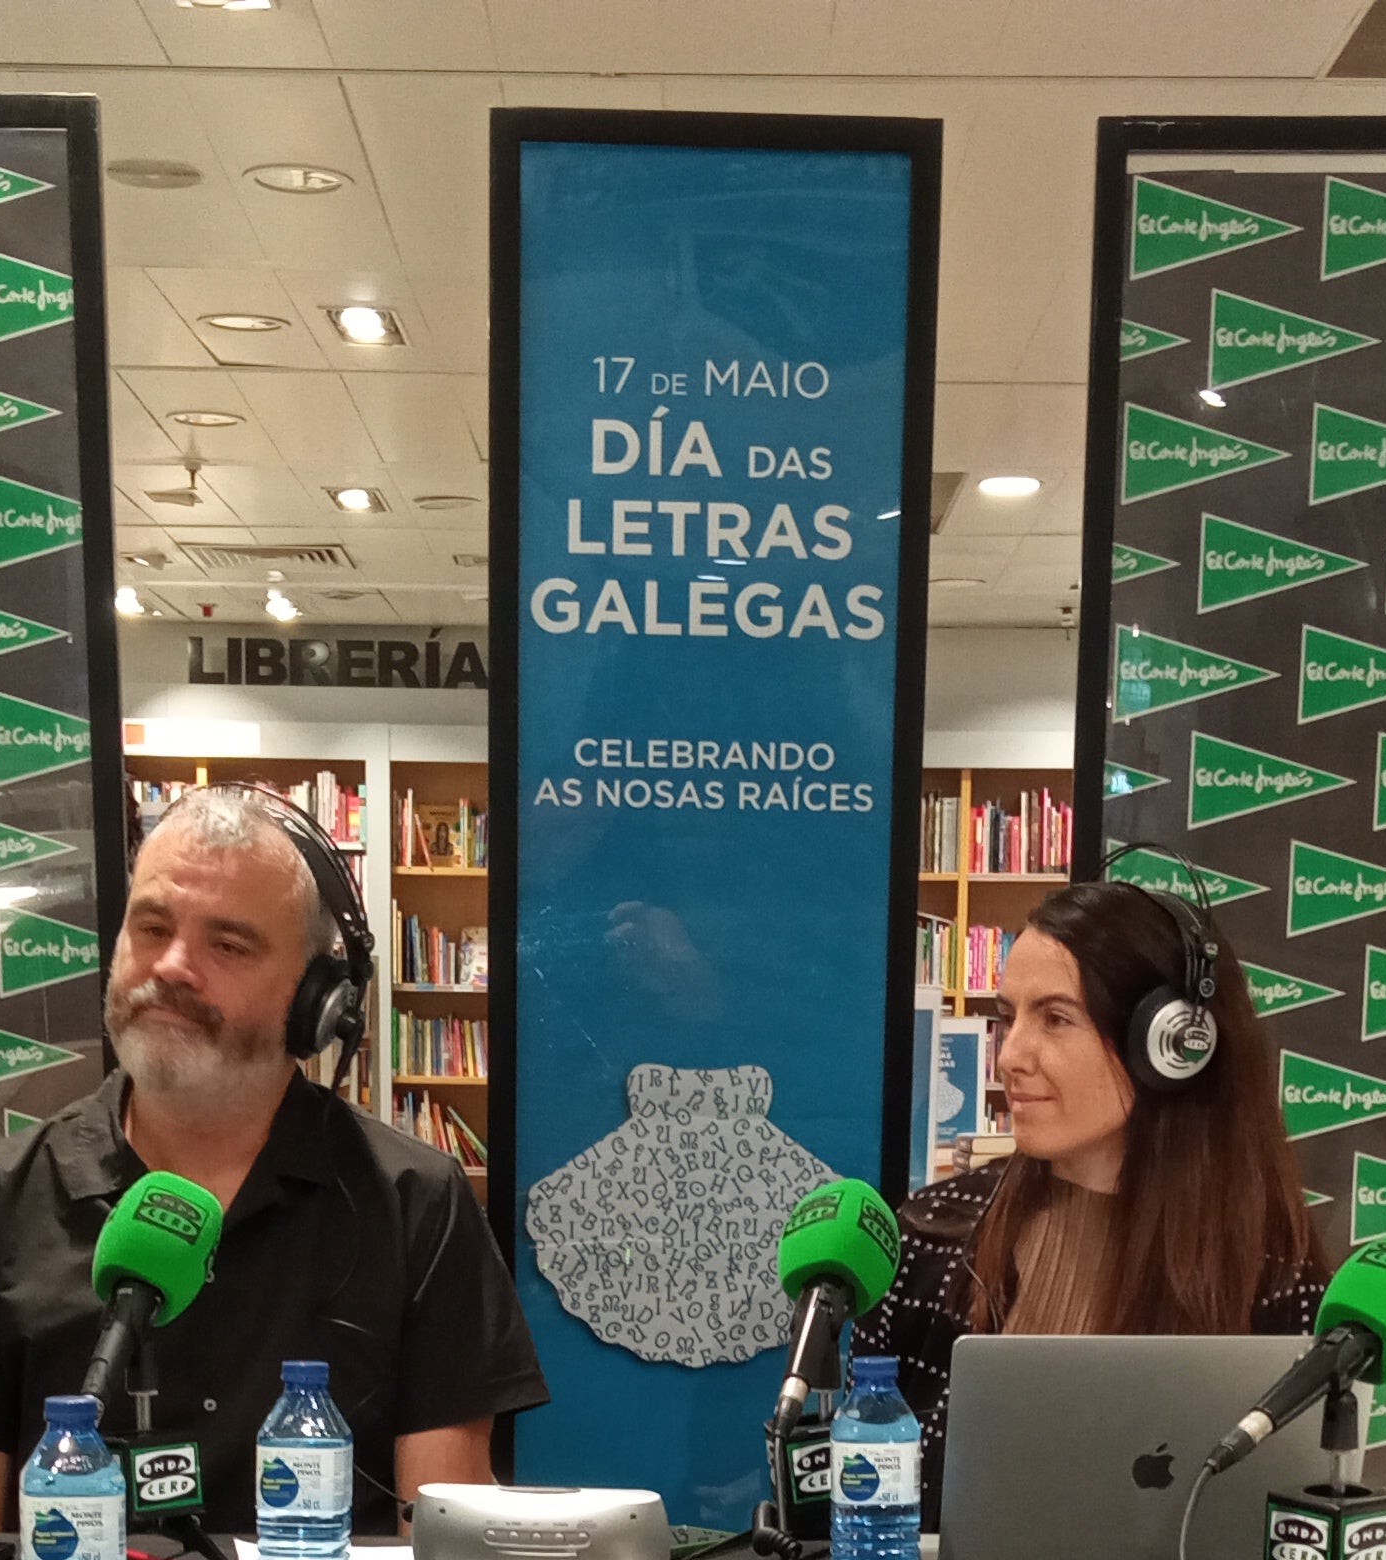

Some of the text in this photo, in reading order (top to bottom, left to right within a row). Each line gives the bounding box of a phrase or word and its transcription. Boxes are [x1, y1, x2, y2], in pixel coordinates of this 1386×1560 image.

[1138, 215, 1156, 235] El
[1157, 215, 1200, 235] Corte
[1329, 215, 1347, 235] El
[1215, 327, 1233, 347] El
[1234, 327, 1277, 347] Corte
[592, 356, 831, 399] 17 DE MAIO
[591, 405, 833, 480] DÍA DAS
[1127, 440, 1146, 460] El
[1147, 441, 1189, 460] Corte
[1317, 441, 1335, 461] El
[1336, 441, 1379, 461] Corte
[567, 498, 853, 560] LETRAS
[1204, 550, 1223, 570] El
[1223, 551, 1265, 570] Corte
[529, 577, 886, 641] GALEGAS
[187, 628, 489, 689] LIBRERÍA
[1305, 661, 1324, 681] El
[1324, 662, 1366, 681] Corte
[574, 737, 836, 771] CELEBRANDO
[1194, 767, 1213, 787] El
[1213, 768, 1255, 787] Corte
[534, 776, 874, 812] AS NOSAS RAÍCES
[1294, 876, 1312, 896] El
[1313, 877, 1354, 896] Corte
[1284, 1085, 1302, 1104] El
[1303, 1086, 1343, 1104] Corte
[142, 1459, 188, 1475] ONDA
[802, 1452, 826, 1468] ON
[147, 1480, 189, 1496] CERO
[808, 1473, 828, 1488] CE
[1278, 1523, 1320, 1542] ONDA
